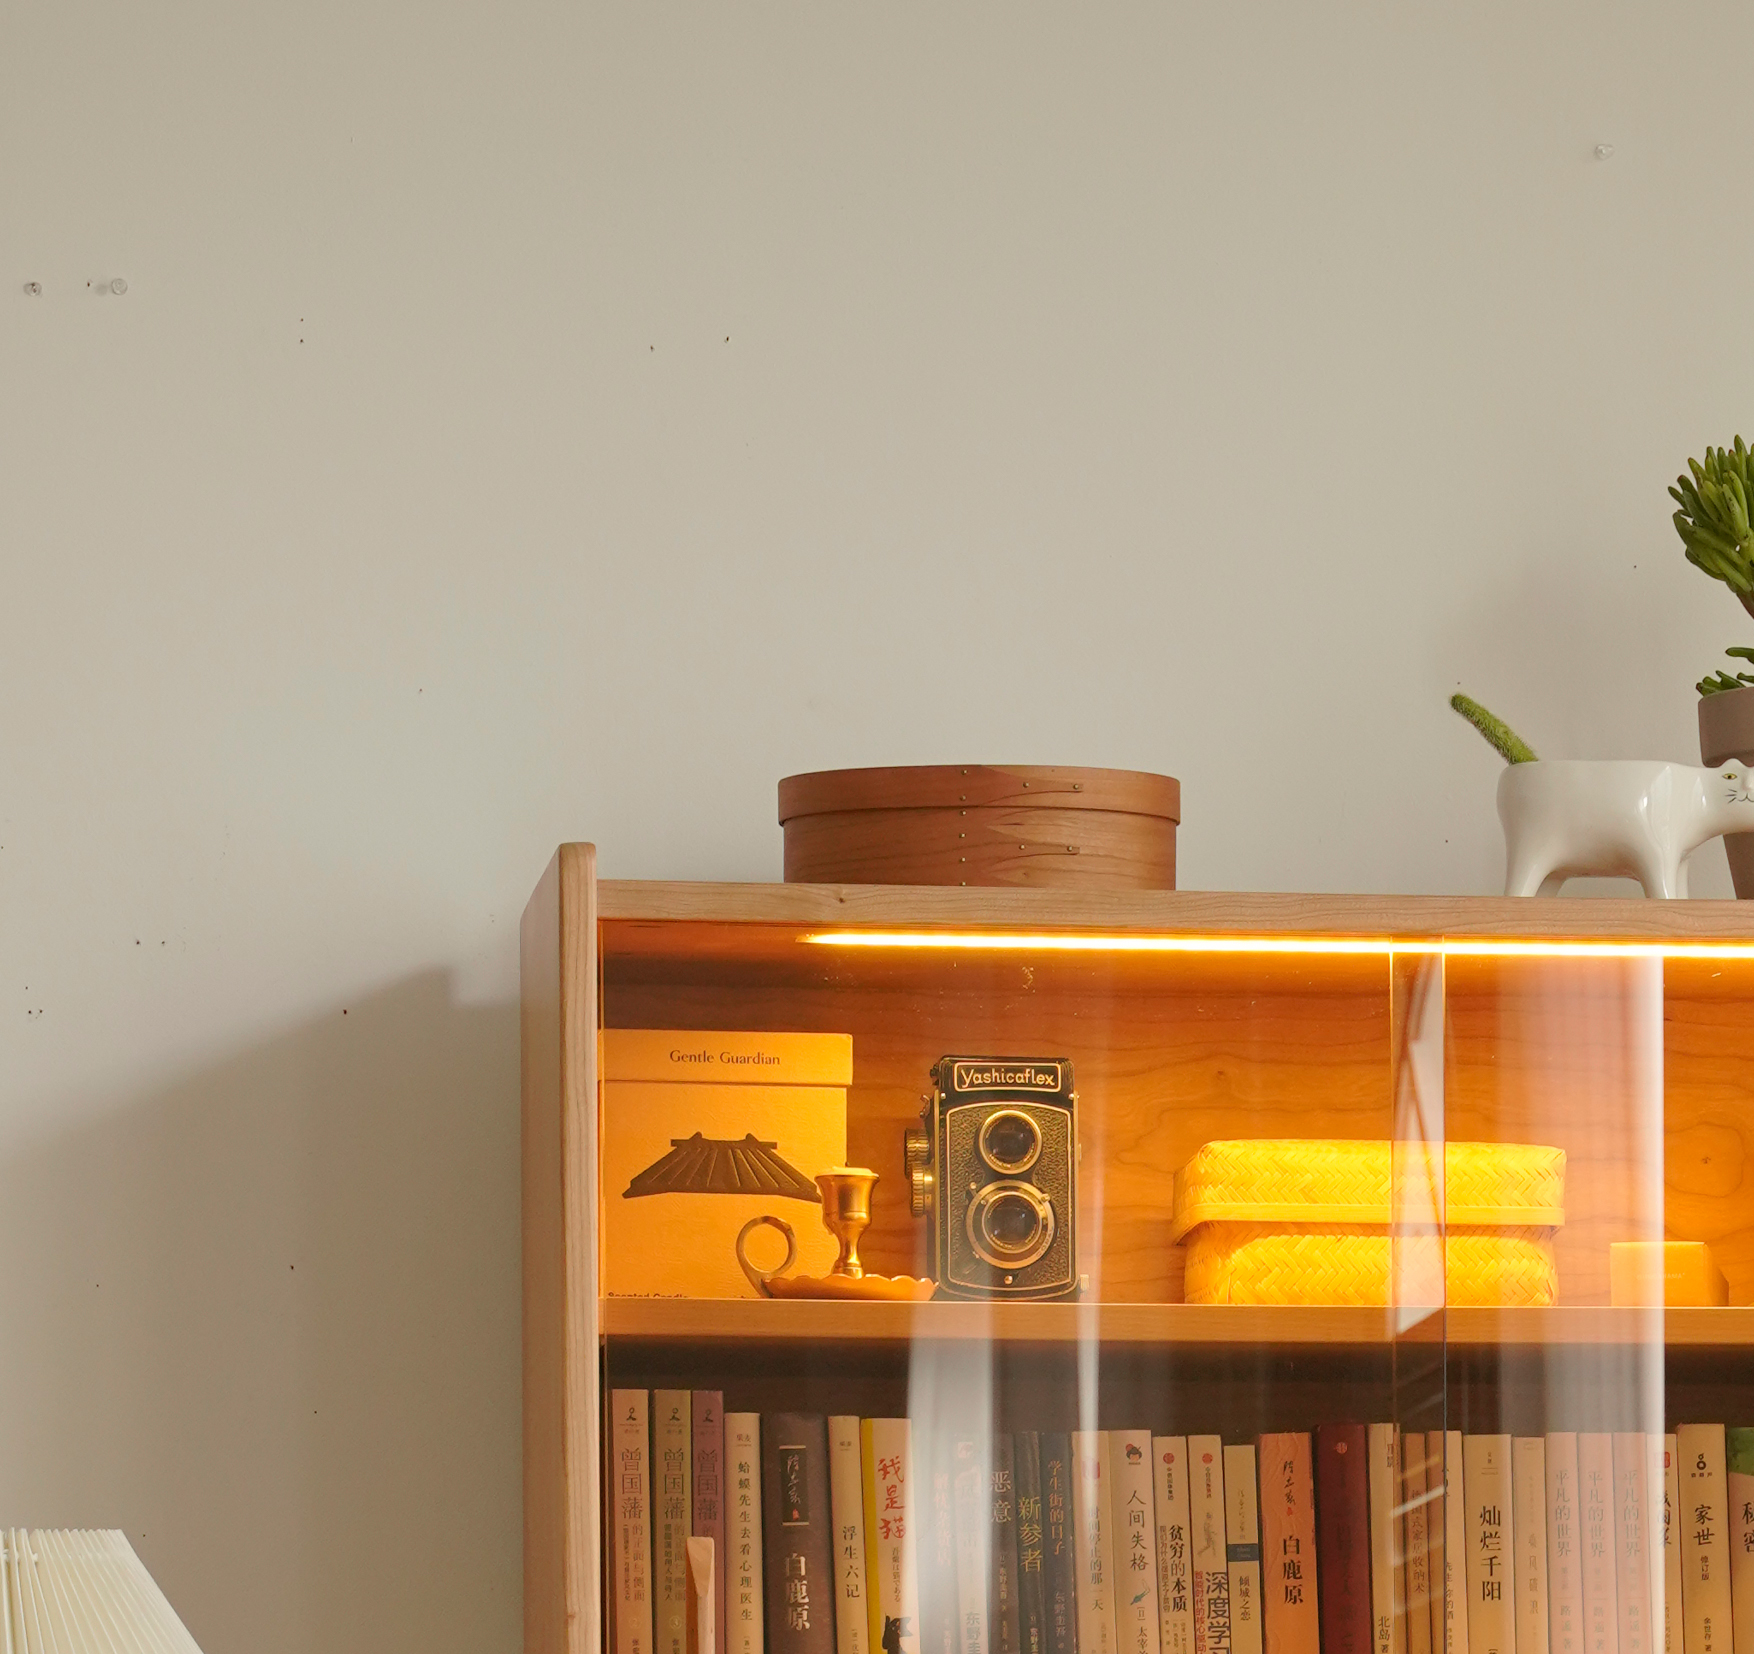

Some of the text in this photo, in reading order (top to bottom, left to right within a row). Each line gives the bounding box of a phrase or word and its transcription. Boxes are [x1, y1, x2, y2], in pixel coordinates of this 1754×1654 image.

[669, 1050, 781, 1065] Gentle Guardian
[960, 1068, 1056, 1088] Yashicaflex
[621, 1446, 644, 1520] 曾国藩
[664, 1446, 685, 1520] 曾国藩
[697, 1449, 718, 1521] 曾国藩
[878, 1455, 906, 1540] 我是猫
[989, 1471, 1012, 1523] 恶意
[1048, 1460, 1066, 1556] 学生街的日子
[1555, 1470, 1573, 1558] 平凡的世界
[1588, 1470, 1606, 1558] 平凡的世界
[1623, 1470, 1642, 1558] 平凡的世界
[738, 1460, 753, 1621] 蛤蟆先生去看心理医生
[842, 1525, 860, 1599] 浮生六记
[1018, 1496, 1043, 1573] 新参者
[1126, 1489, 1150, 1572] 人间失格
[1480, 1505, 1501, 1602] 灿烂千阳
[1692, 1503, 1715, 1547] 家世
[786, 1552, 810, 1630] 白鹿原
[1168, 1524, 1188, 1613] 贫穷的本质
[1238, 1575, 1251, 1622] 倾城之恋
[1282, 1535, 1304, 1606] 白鹿原
[1700, 1555, 1710, 1581] 修订版
[1377, 1615, 1391, 1642] 北岛
